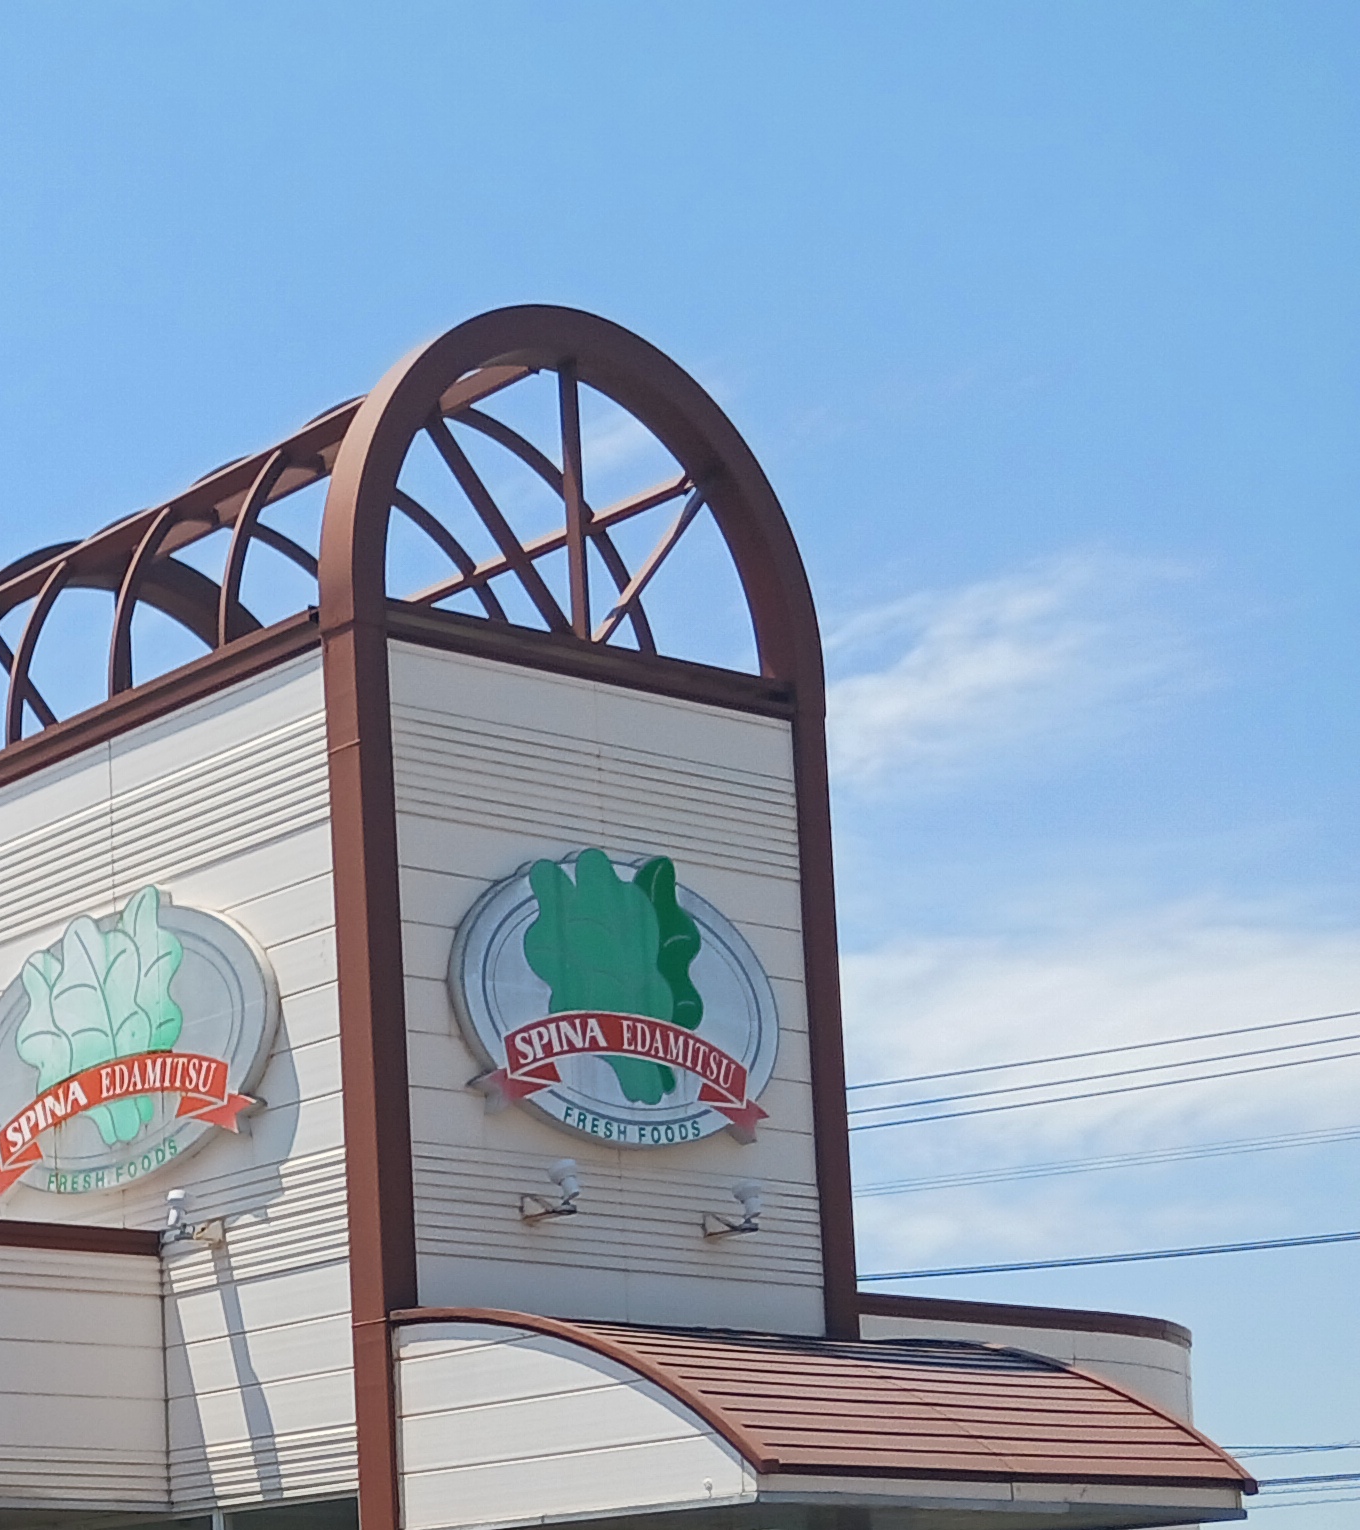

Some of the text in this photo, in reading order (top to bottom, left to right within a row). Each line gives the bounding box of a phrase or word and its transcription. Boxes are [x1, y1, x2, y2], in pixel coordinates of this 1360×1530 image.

[514, 1018, 736, 1089] SPINA EDAMITSU
[5, 1056, 217, 1153] SPINA EDAMITSU
[563, 1106, 701, 1144] FRESH FOODS
[46, 1136, 179, 1192] FRESH FOODS
